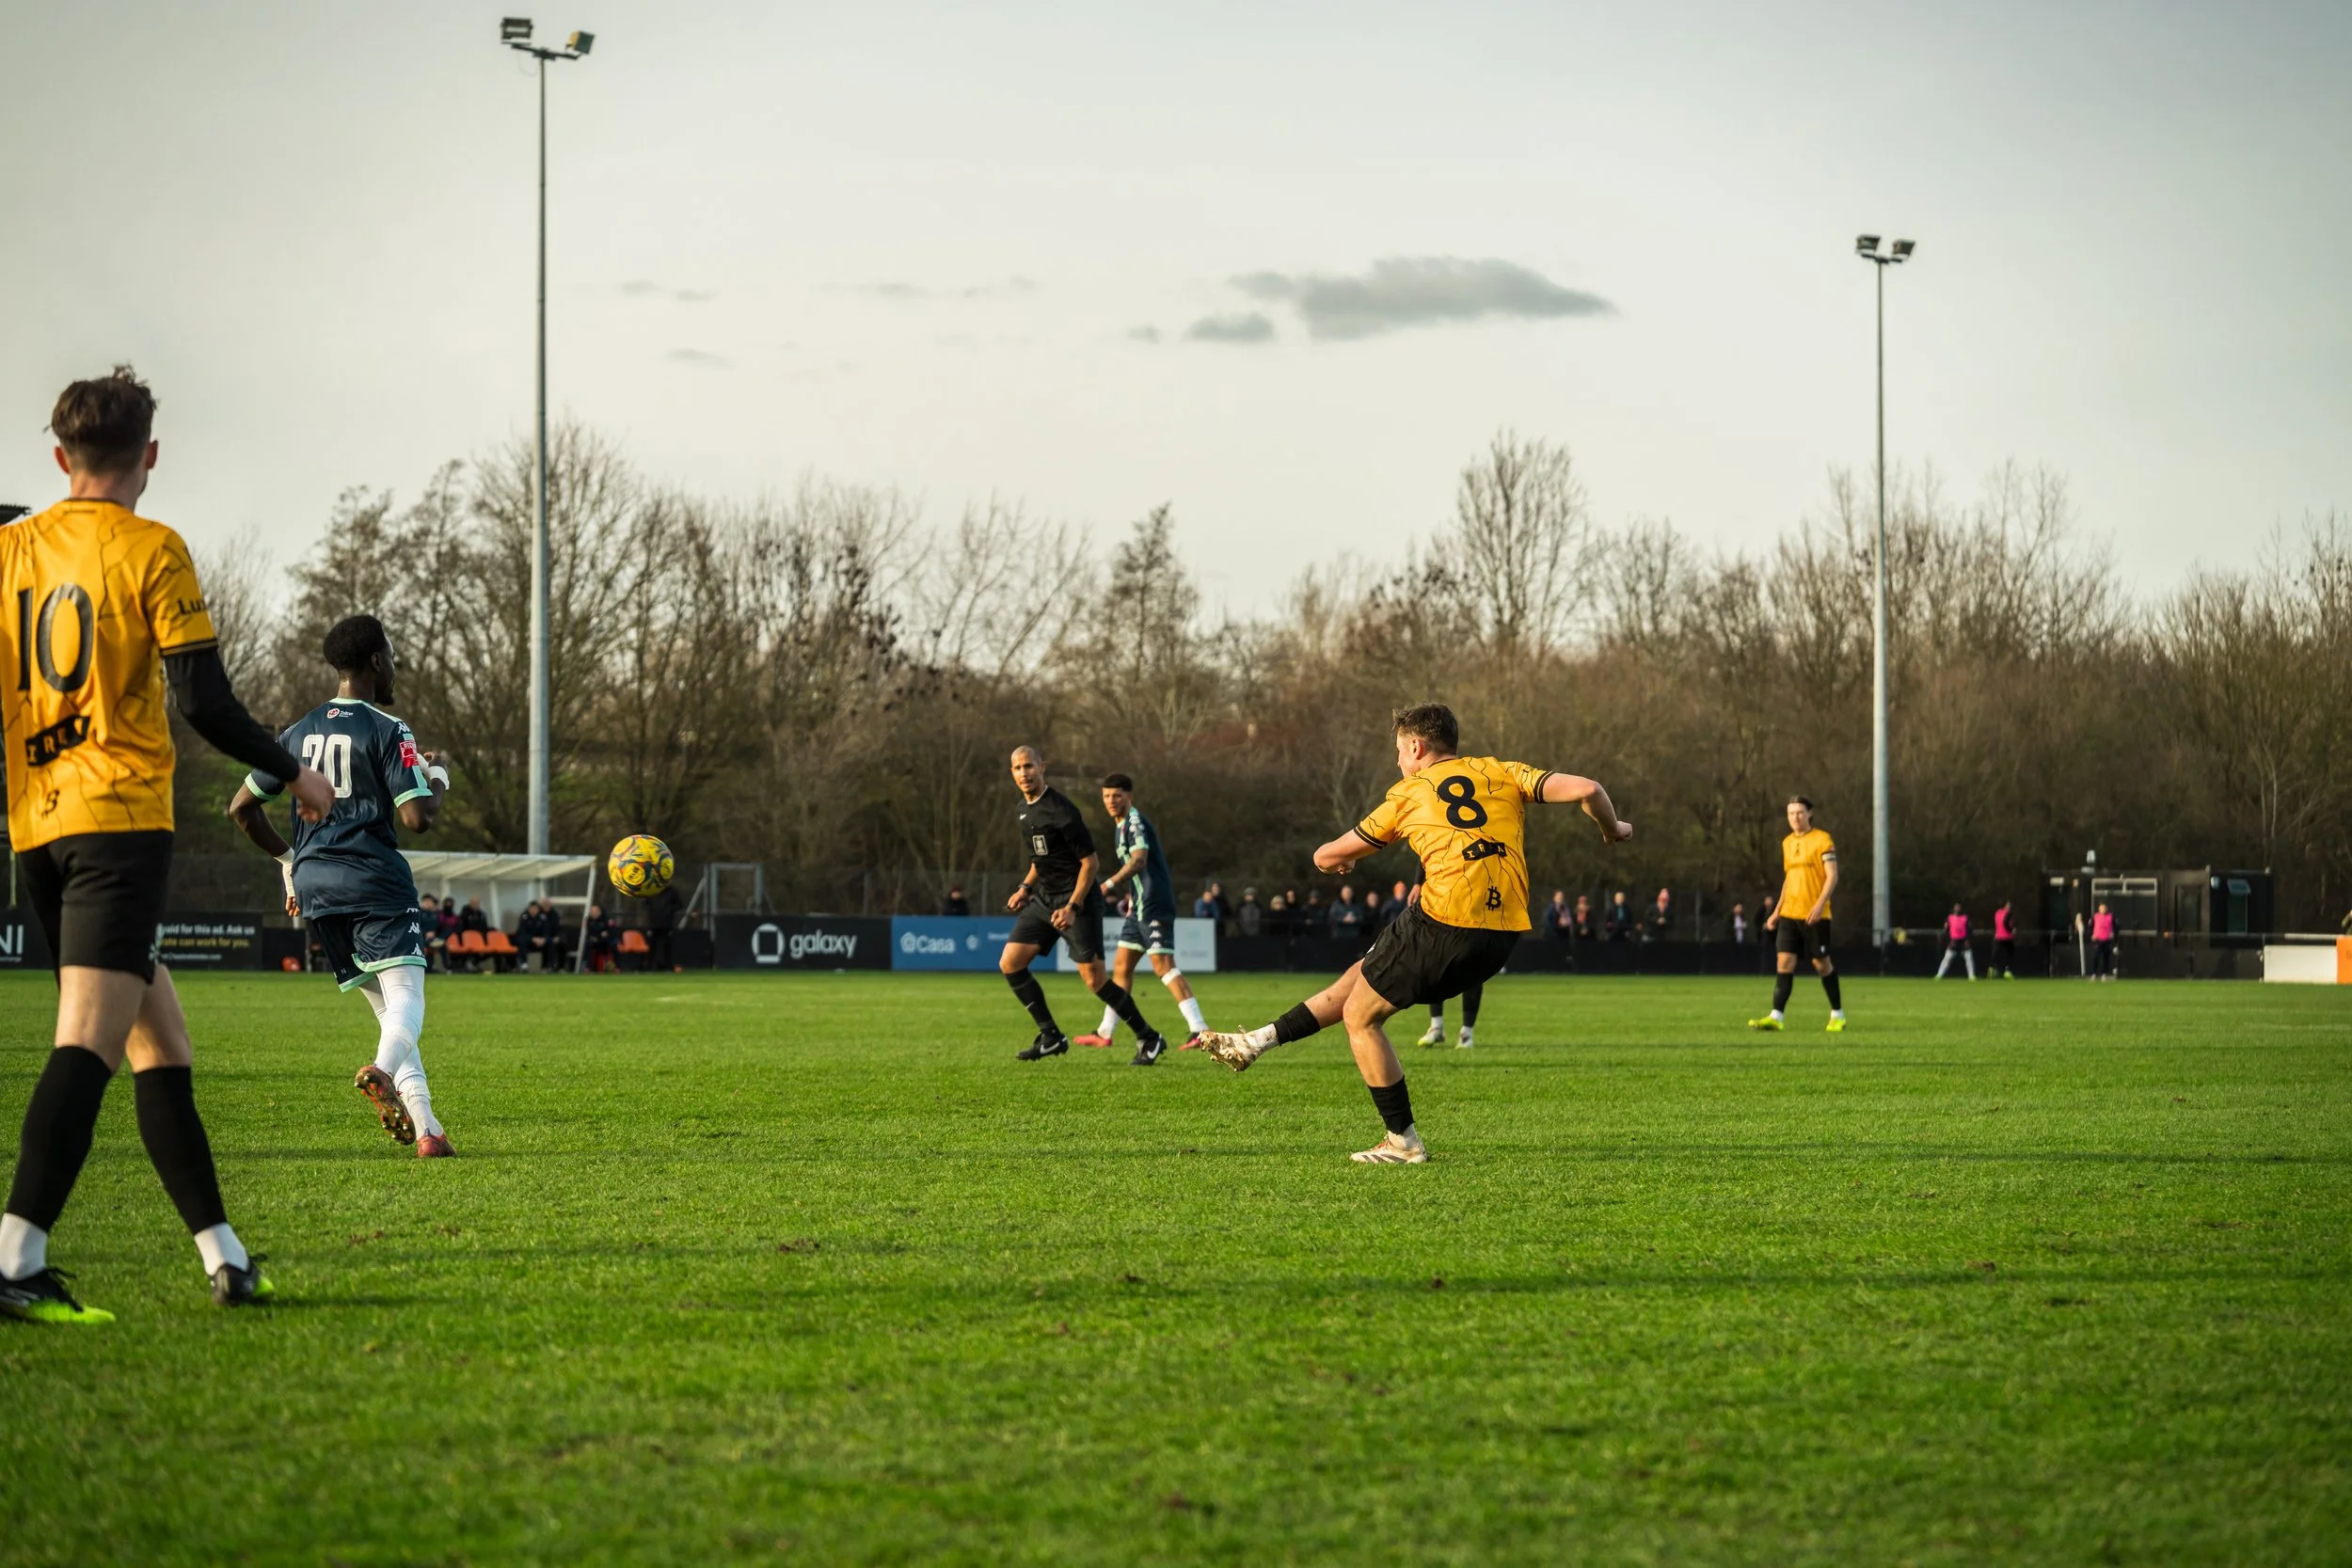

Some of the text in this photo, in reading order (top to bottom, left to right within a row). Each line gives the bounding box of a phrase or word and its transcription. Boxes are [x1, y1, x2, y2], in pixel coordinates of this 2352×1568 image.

[17, 582, 93, 692] 10
[1437, 775, 1488, 829] 8
[181, 924, 193, 934] for
[195, 924, 210, 934] this
[226, 924, 242, 935] Ask
[789, 928, 858, 959] galaxy
[915, 935, 956, 954] Casa
